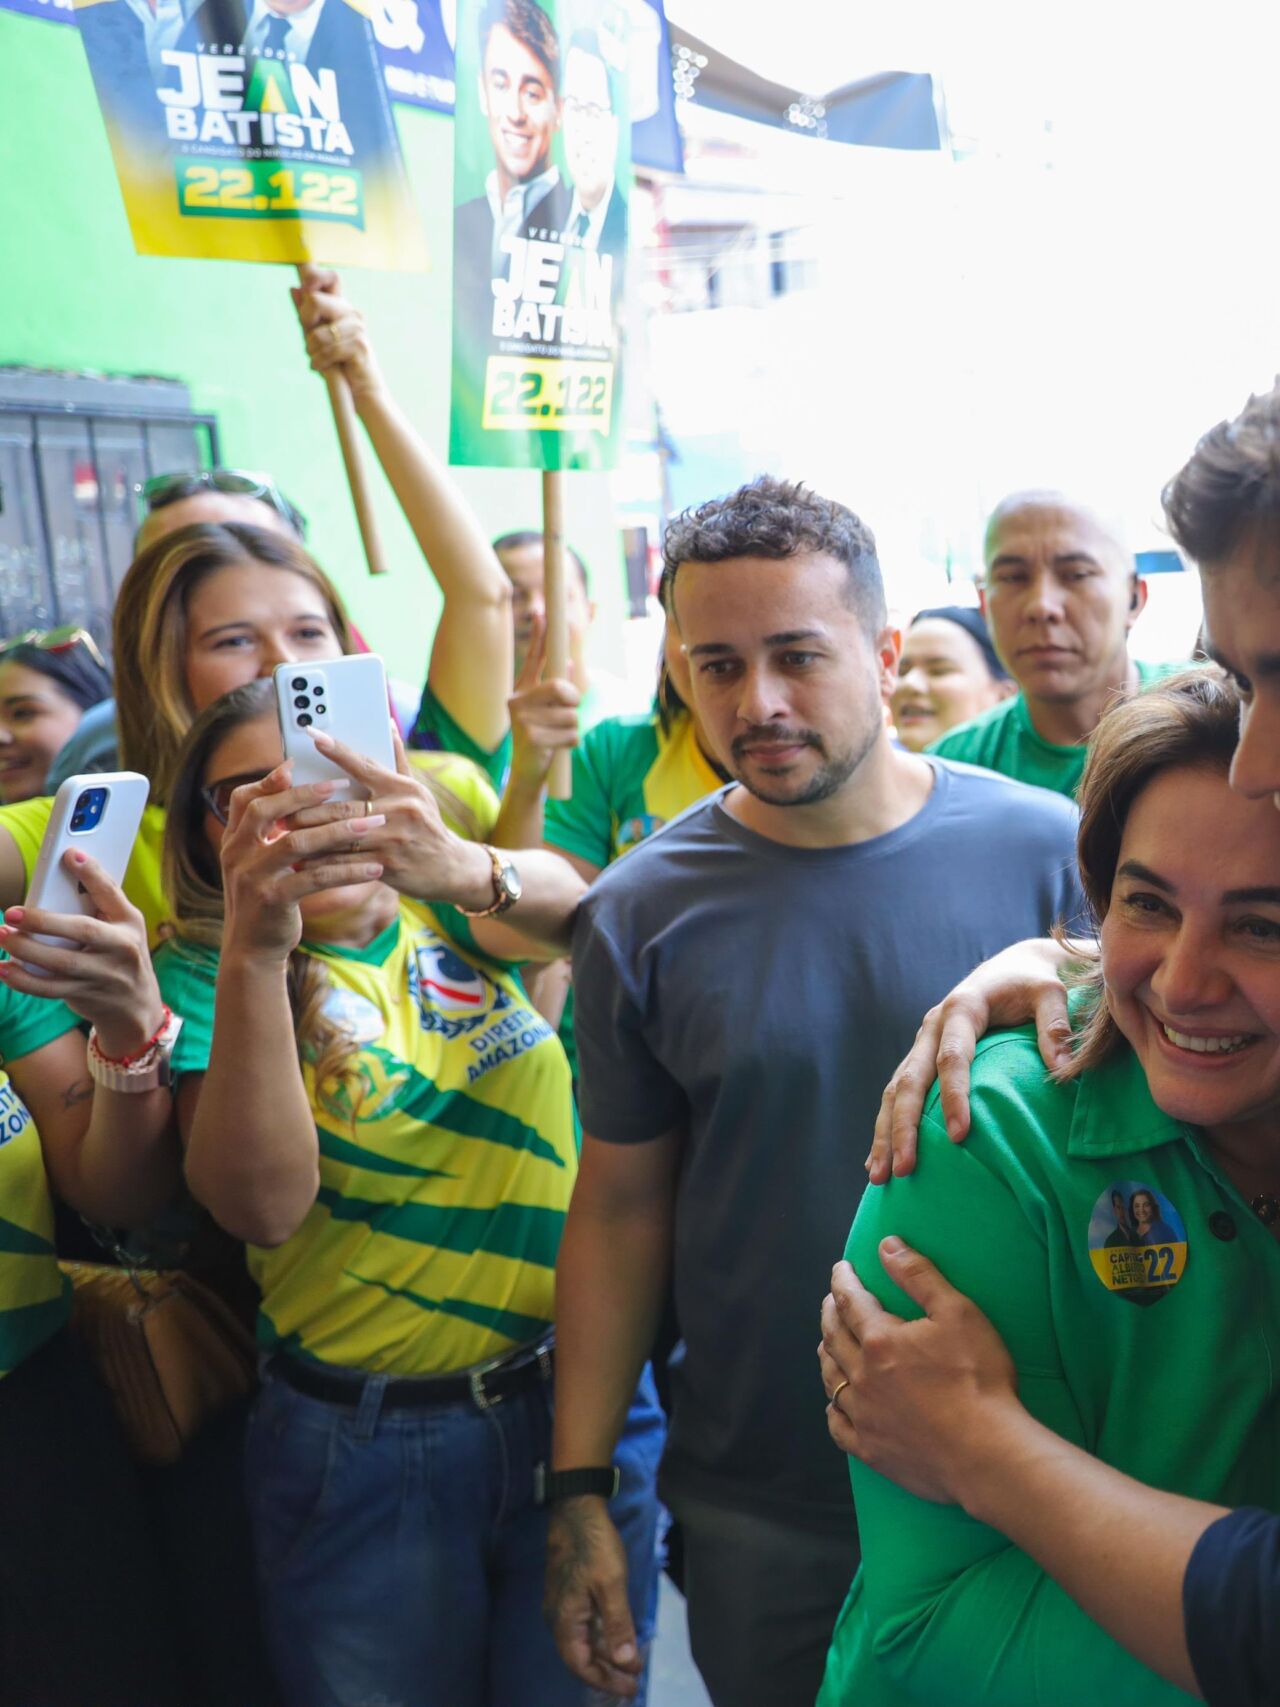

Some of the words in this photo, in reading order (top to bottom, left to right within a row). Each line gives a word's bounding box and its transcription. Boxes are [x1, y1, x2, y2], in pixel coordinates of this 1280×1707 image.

[156, 50, 340, 121] JEAN
[165, 107, 354, 155] BATISTA
[184, 166, 359, 216] 22.122
[491, 371, 606, 416] 22.122
[1144, 1247, 1177, 1282] 22
